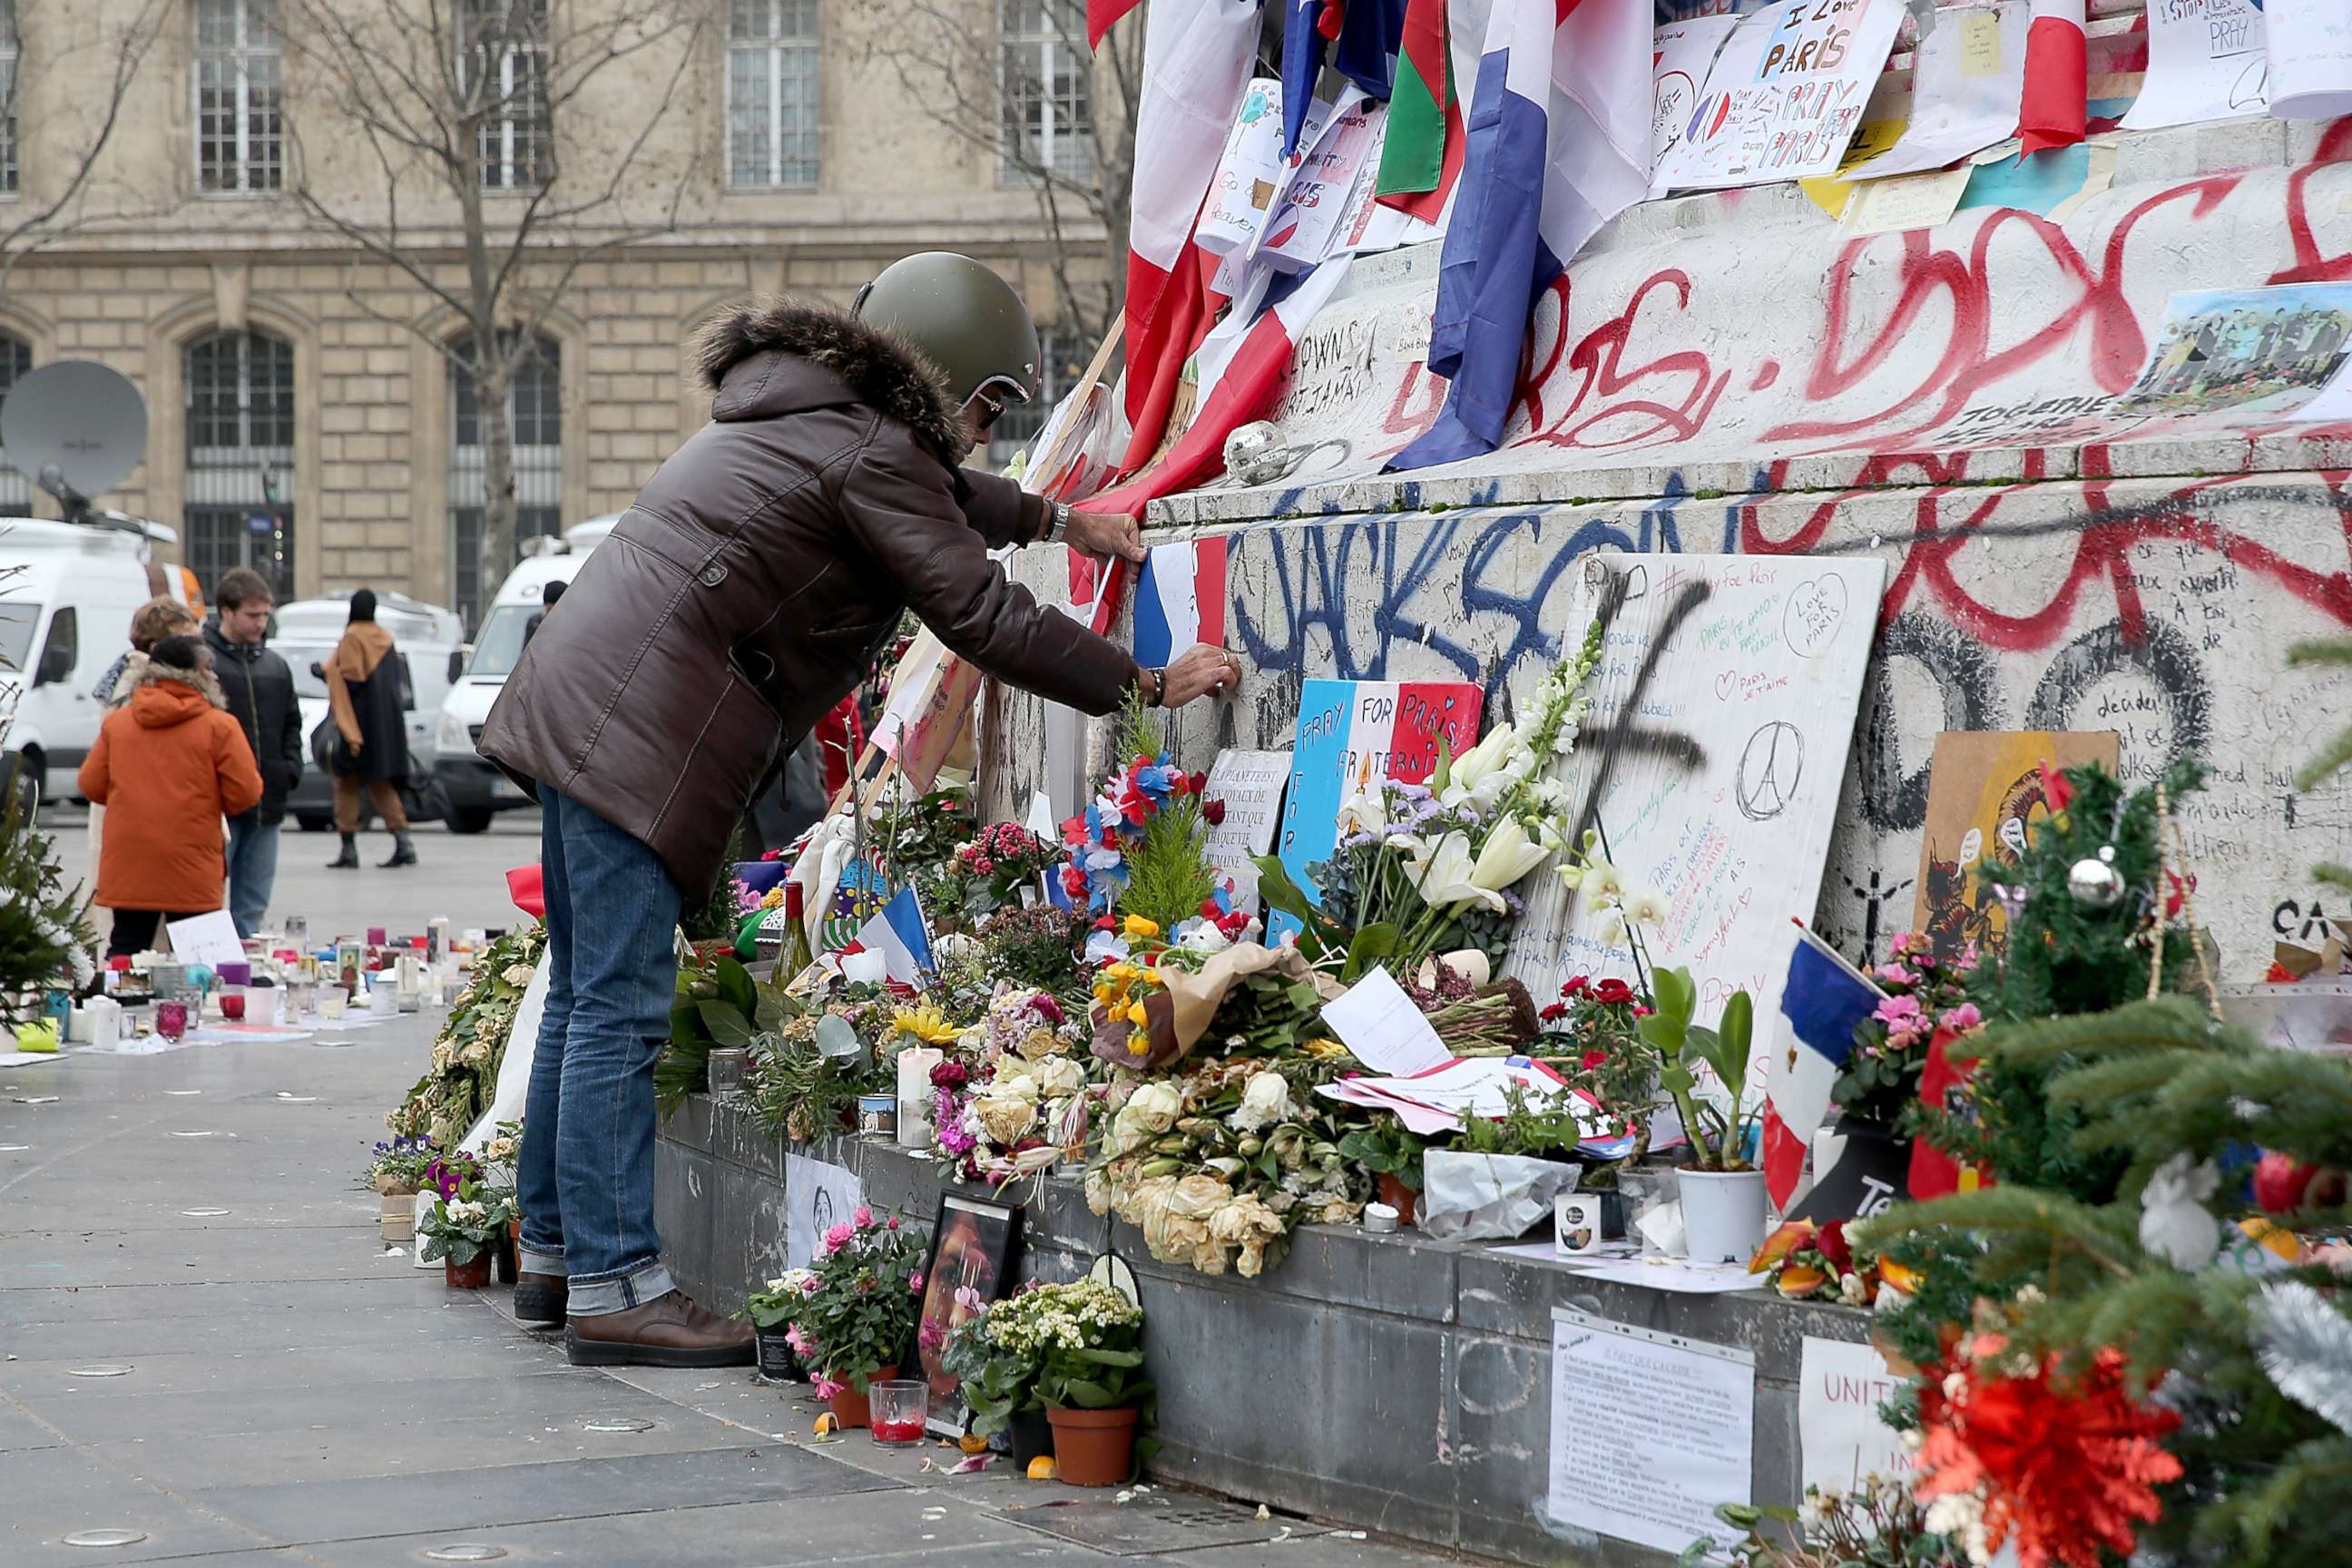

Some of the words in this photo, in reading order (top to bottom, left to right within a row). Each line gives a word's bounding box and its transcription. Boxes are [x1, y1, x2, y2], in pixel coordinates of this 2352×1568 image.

[1795, 587, 1828, 618] LOVE
[1806, 606, 1841, 647] PARIS
[1740, 672, 1766, 690] PARIS
[1302, 699, 1345, 752] PRAY
[1362, 696, 1394, 727] FOR
[1824, 1372, 1898, 1406] UNIT
